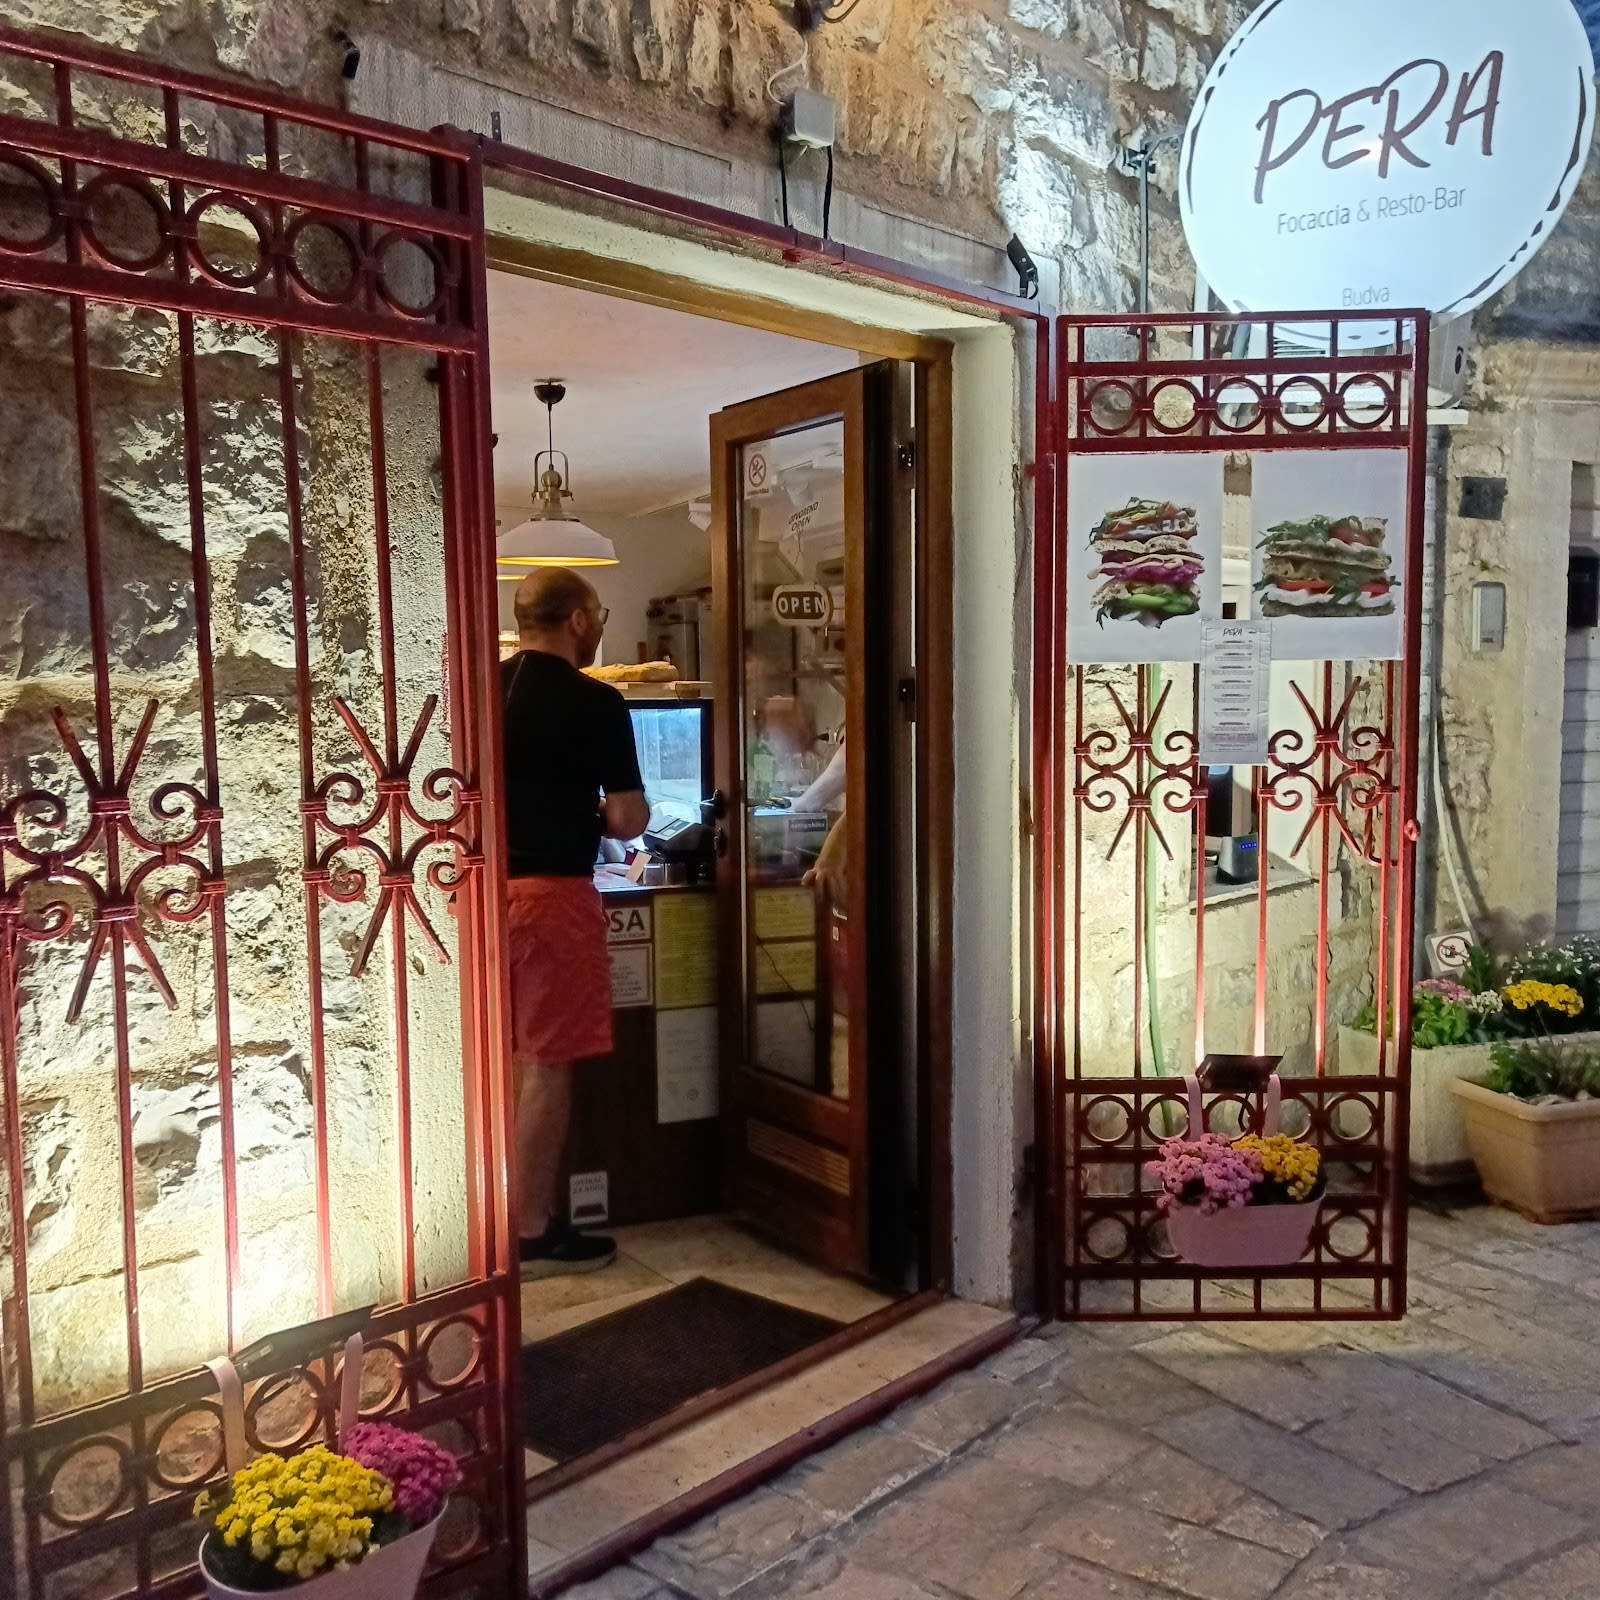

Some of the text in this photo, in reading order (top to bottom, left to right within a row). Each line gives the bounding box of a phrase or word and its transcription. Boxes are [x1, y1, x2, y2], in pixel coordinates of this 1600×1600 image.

[1254, 50, 1503, 204] PERA
[1277, 186, 1466, 235] Focaccia & Resto-Bar
[1342, 285, 1390, 306] Budva
[778, 595, 826, 614] OPEN
